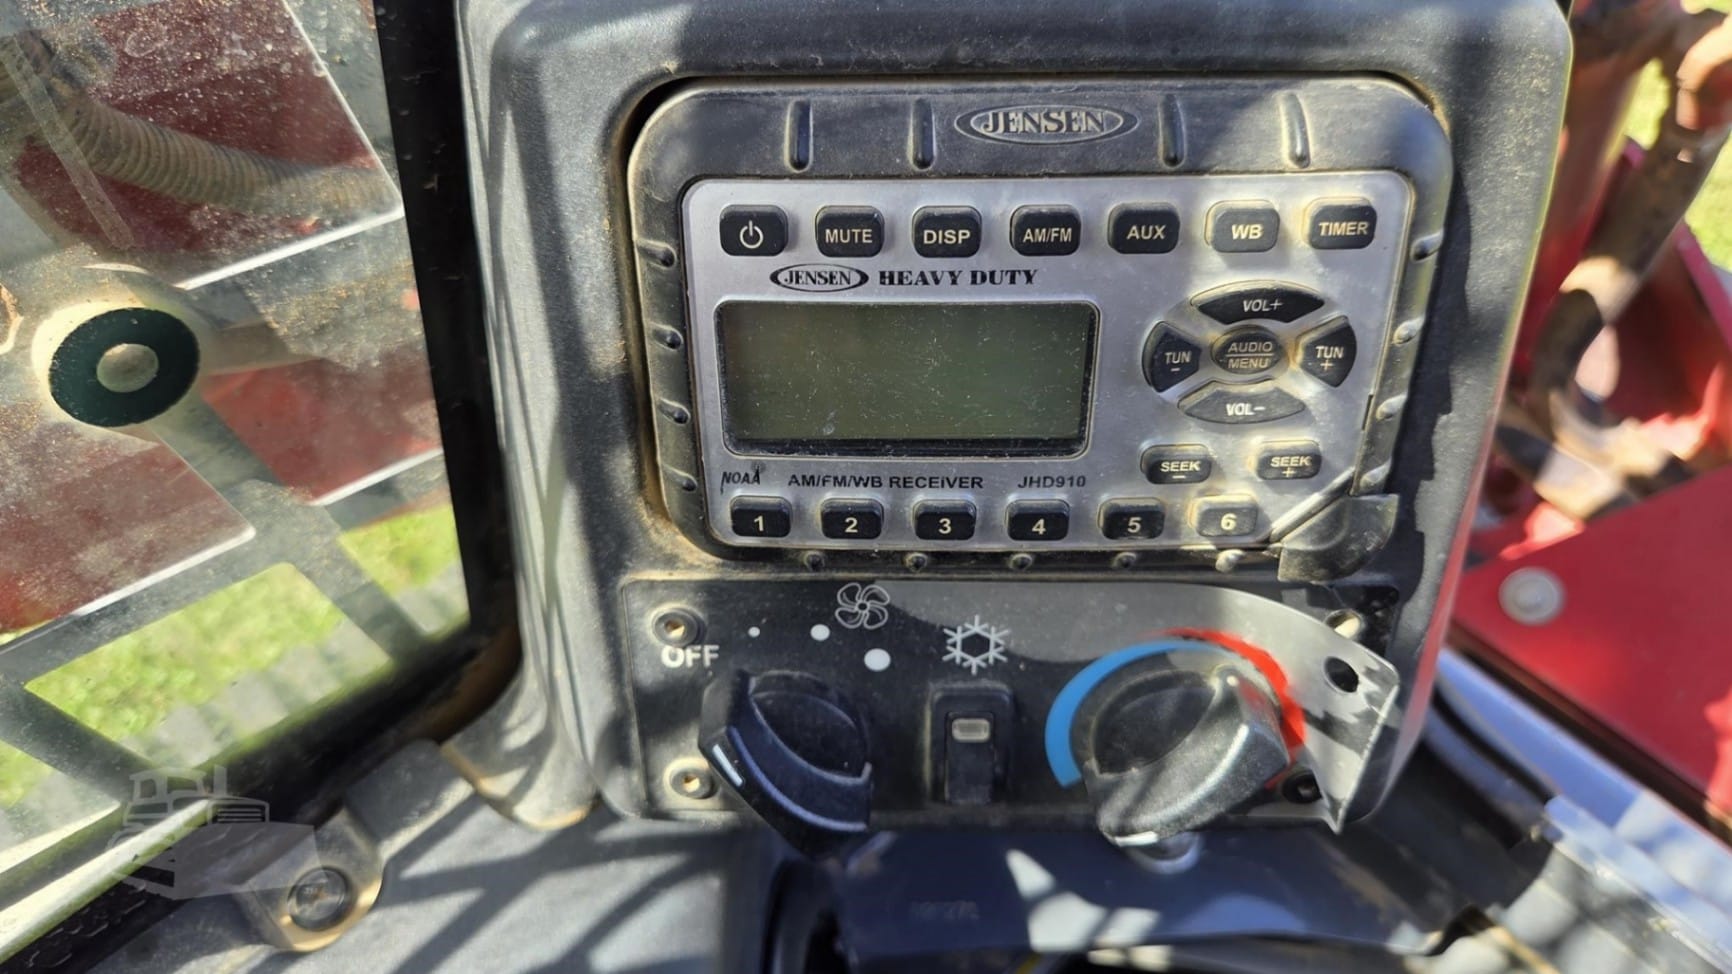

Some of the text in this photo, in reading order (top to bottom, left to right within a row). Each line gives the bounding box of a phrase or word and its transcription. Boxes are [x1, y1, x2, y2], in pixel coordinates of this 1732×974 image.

[982, 111, 1105, 133] JENSEN
[825, 228, 873, 244] MUTE
[923, 228, 971, 244] DISP
[1023, 227, 1072, 243] AM/FM
[1127, 225, 1165, 240] AUX
[1231, 224, 1264, 240] WB
[1318, 221, 1369, 236] TIMER
[784, 269, 1038, 286] JENSEN HEAVY DUTY
[1227, 340, 1274, 354] AUDIO
[1315, 345, 1344, 359] TUN
[1164, 351, 1191, 364] TUN
[1228, 356, 1271, 369] MENU
[1160, 461, 1201, 472] SEEK
[1271, 455, 1311, 468] SEEK
[720, 464, 761, 495] NOAA
[788, 474, 984, 489] AM/FM/WB RECEIVER
[1017, 474, 1087, 489] JHD910
[753, 515, 765, 532] 1
[844, 517, 858, 533] 2
[938, 518, 952, 534] 3
[1031, 518, 1046, 535] 4
[1127, 517, 1141, 533] 5
[1221, 514, 1236, 531] 6
[660, 644, 720, 668] OFF
